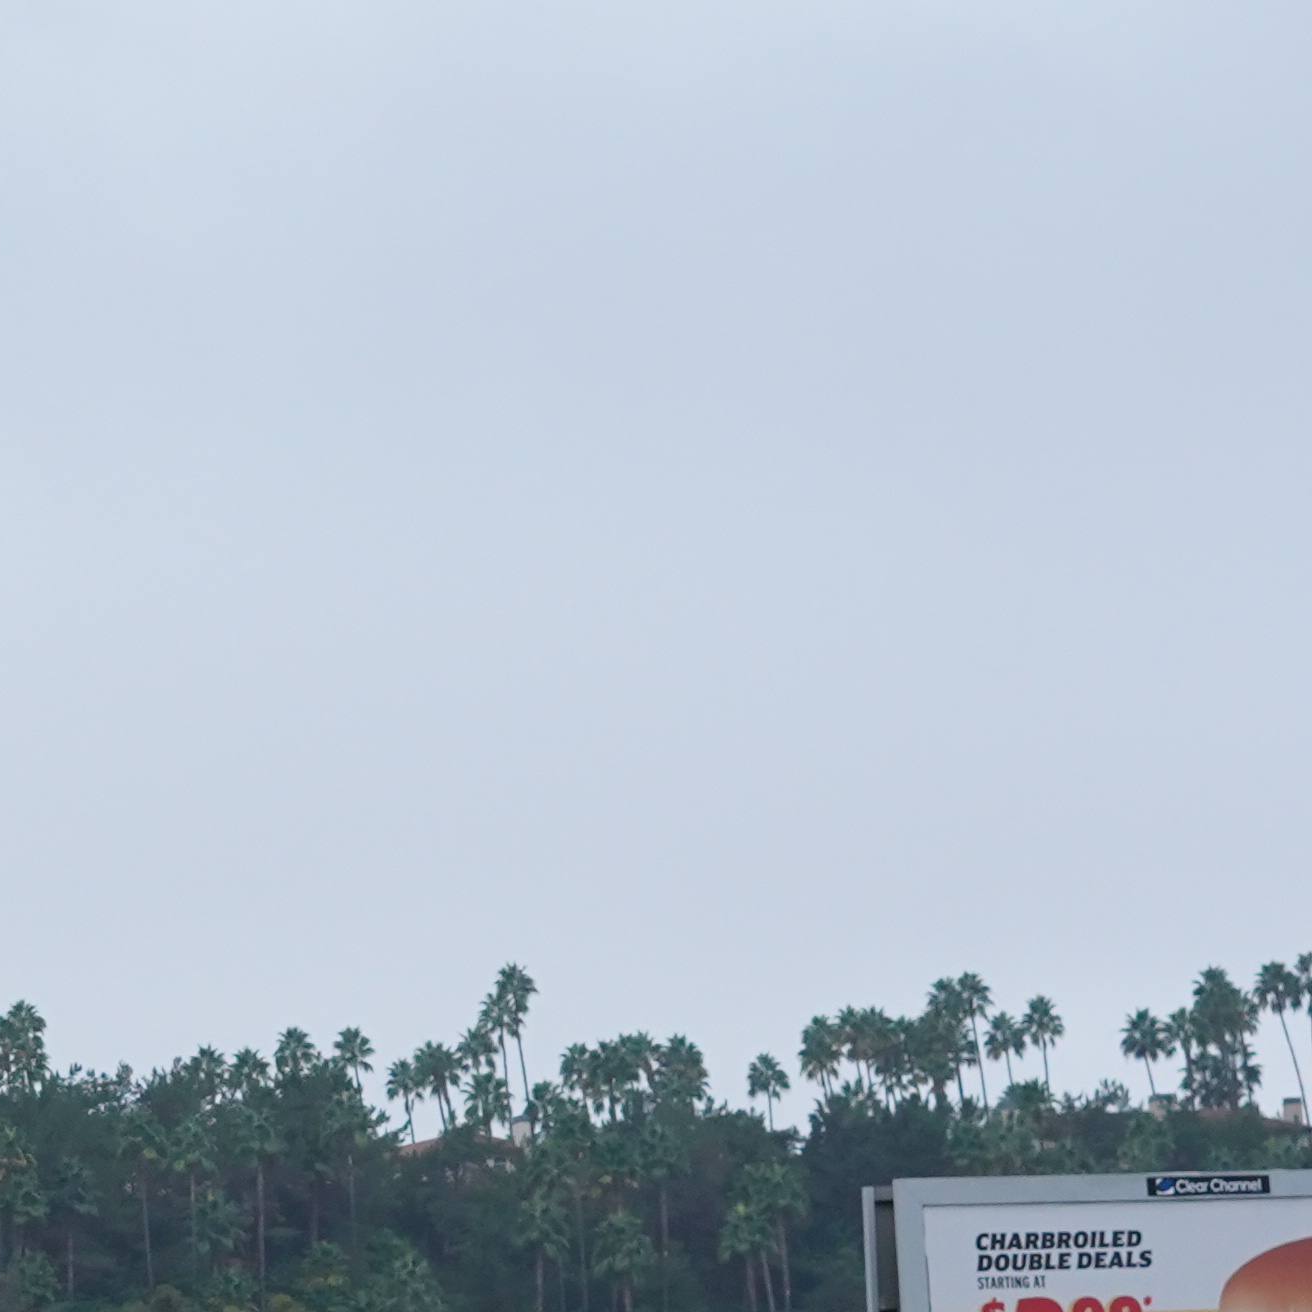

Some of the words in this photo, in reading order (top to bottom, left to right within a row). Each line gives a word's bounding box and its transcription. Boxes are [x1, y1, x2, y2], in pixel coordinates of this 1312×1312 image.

[1176, 1178, 1209, 1193] Clear
[1210, 1177, 1263, 1192] Channel
[976, 1230, 1143, 1250] CHARBROILED
[977, 1252, 1071, 1272] DOUBLE
[1077, 1250, 1153, 1270] DEALS
[977, 1275, 1030, 1290] STARTING
[1033, 1275, 1046, 1289] AT
